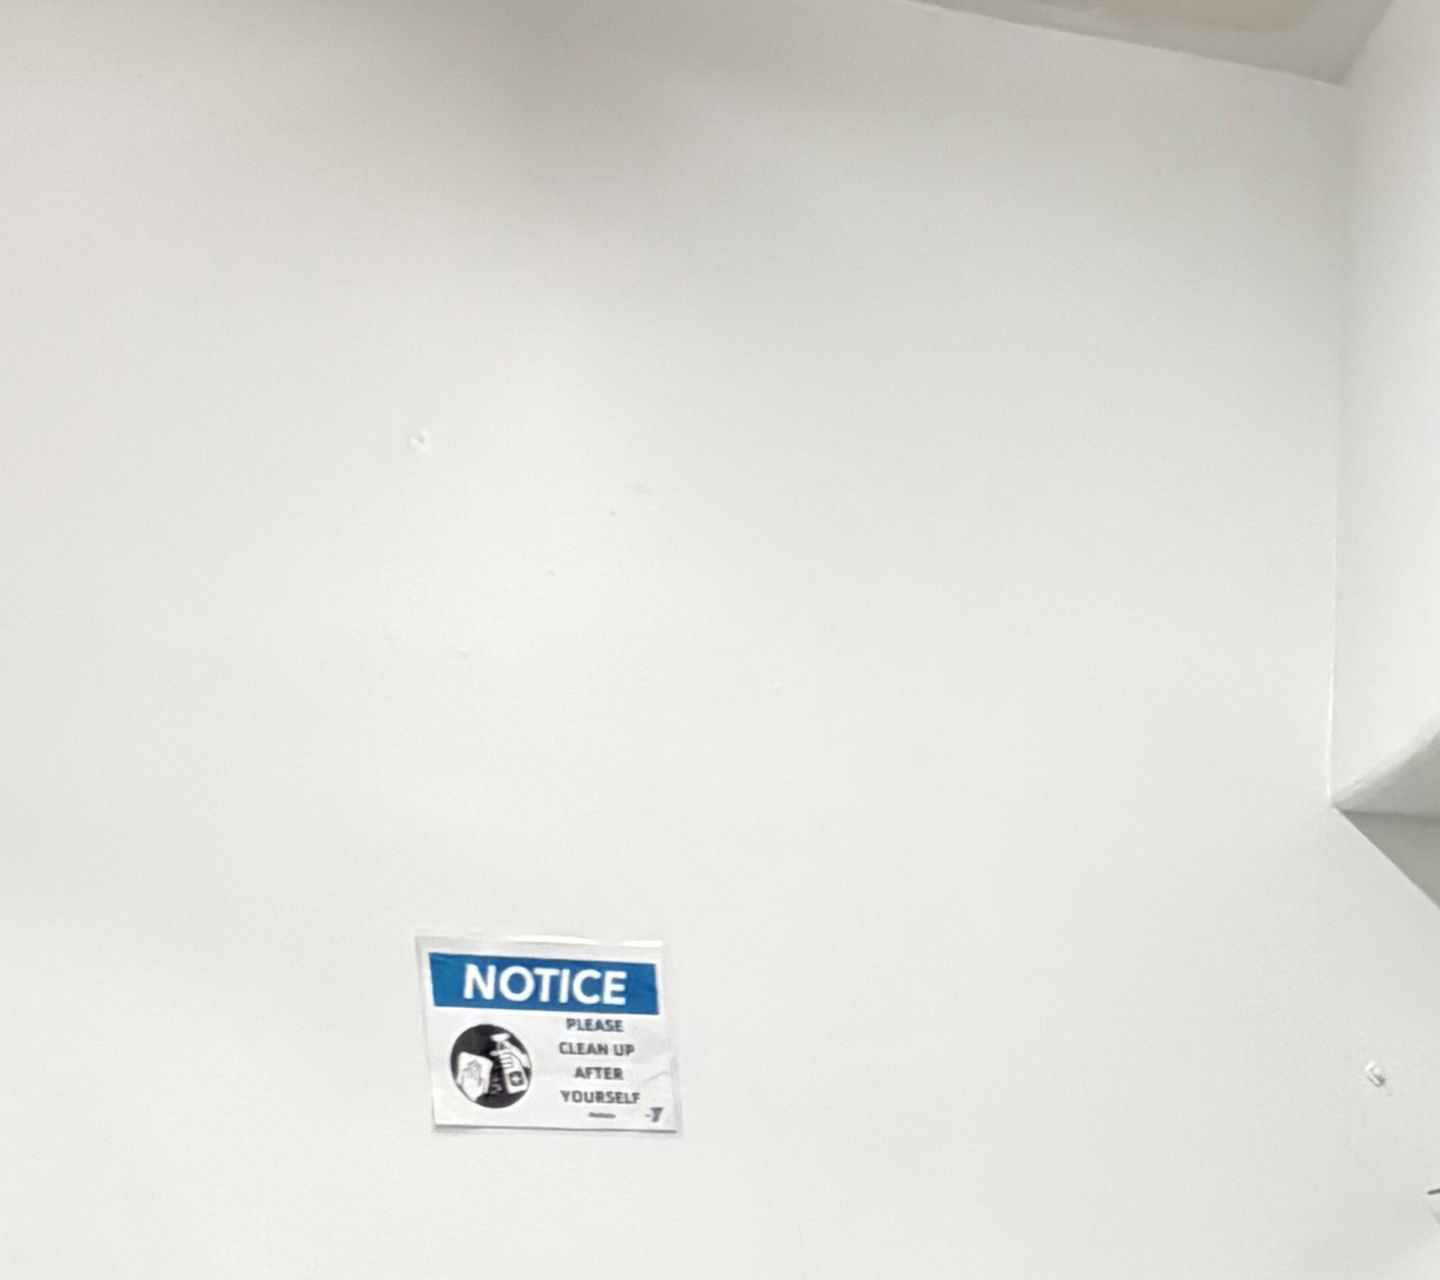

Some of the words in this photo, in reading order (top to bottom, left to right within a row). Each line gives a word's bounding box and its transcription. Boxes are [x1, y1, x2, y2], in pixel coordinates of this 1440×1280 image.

[463, 964, 627, 1005] NOTICE
[566, 1018, 624, 1032] PLEASE
[559, 1041, 609, 1056] CLEAN
[612, 1043, 635, 1057] UP
[574, 1067, 624, 1081] AFTER
[560, 1090, 641, 1105] YOURSELF
